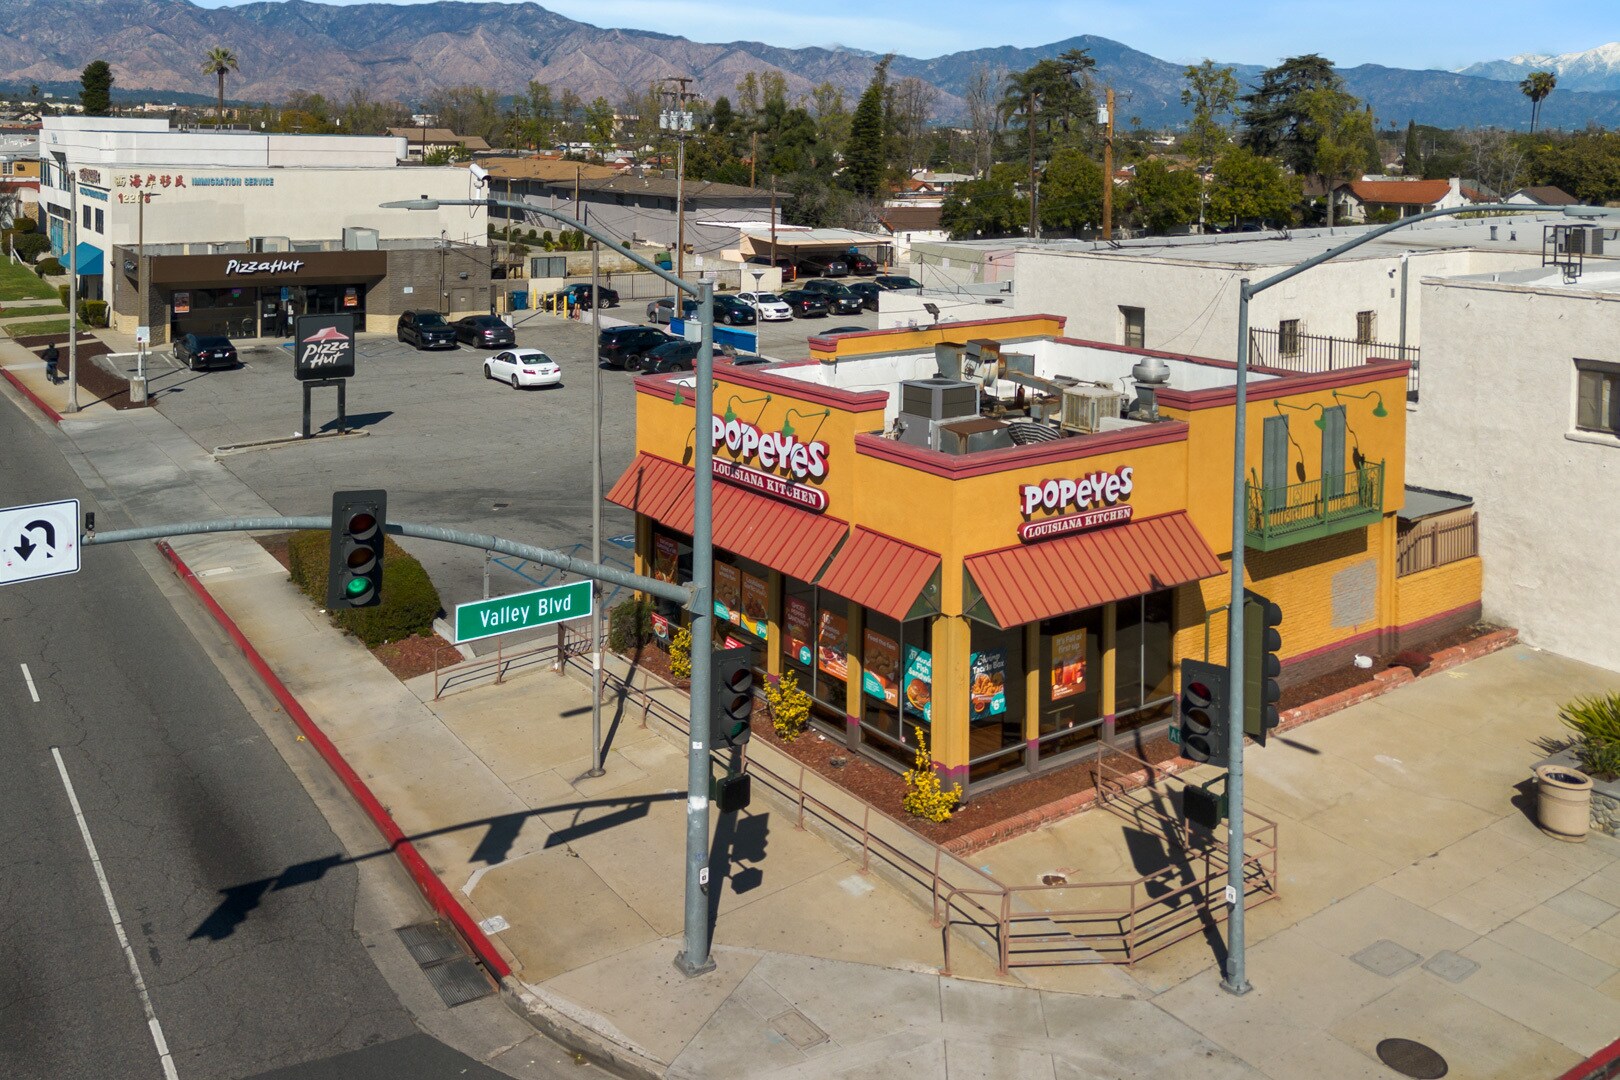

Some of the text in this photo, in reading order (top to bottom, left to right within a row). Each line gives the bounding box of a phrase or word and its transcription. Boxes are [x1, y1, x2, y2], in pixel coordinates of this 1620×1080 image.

[191, 177, 274, 187] IMMIGRATION SERVICE
[302, 339, 349, 363] Pizza
[310, 351, 344, 369] Hut
[712, 461, 817, 506] LOUISIANA KITCHEN
[1028, 508, 1131, 538] LOUISIANA KITCHEN
[480, 594, 571, 628] Valley Blvd
